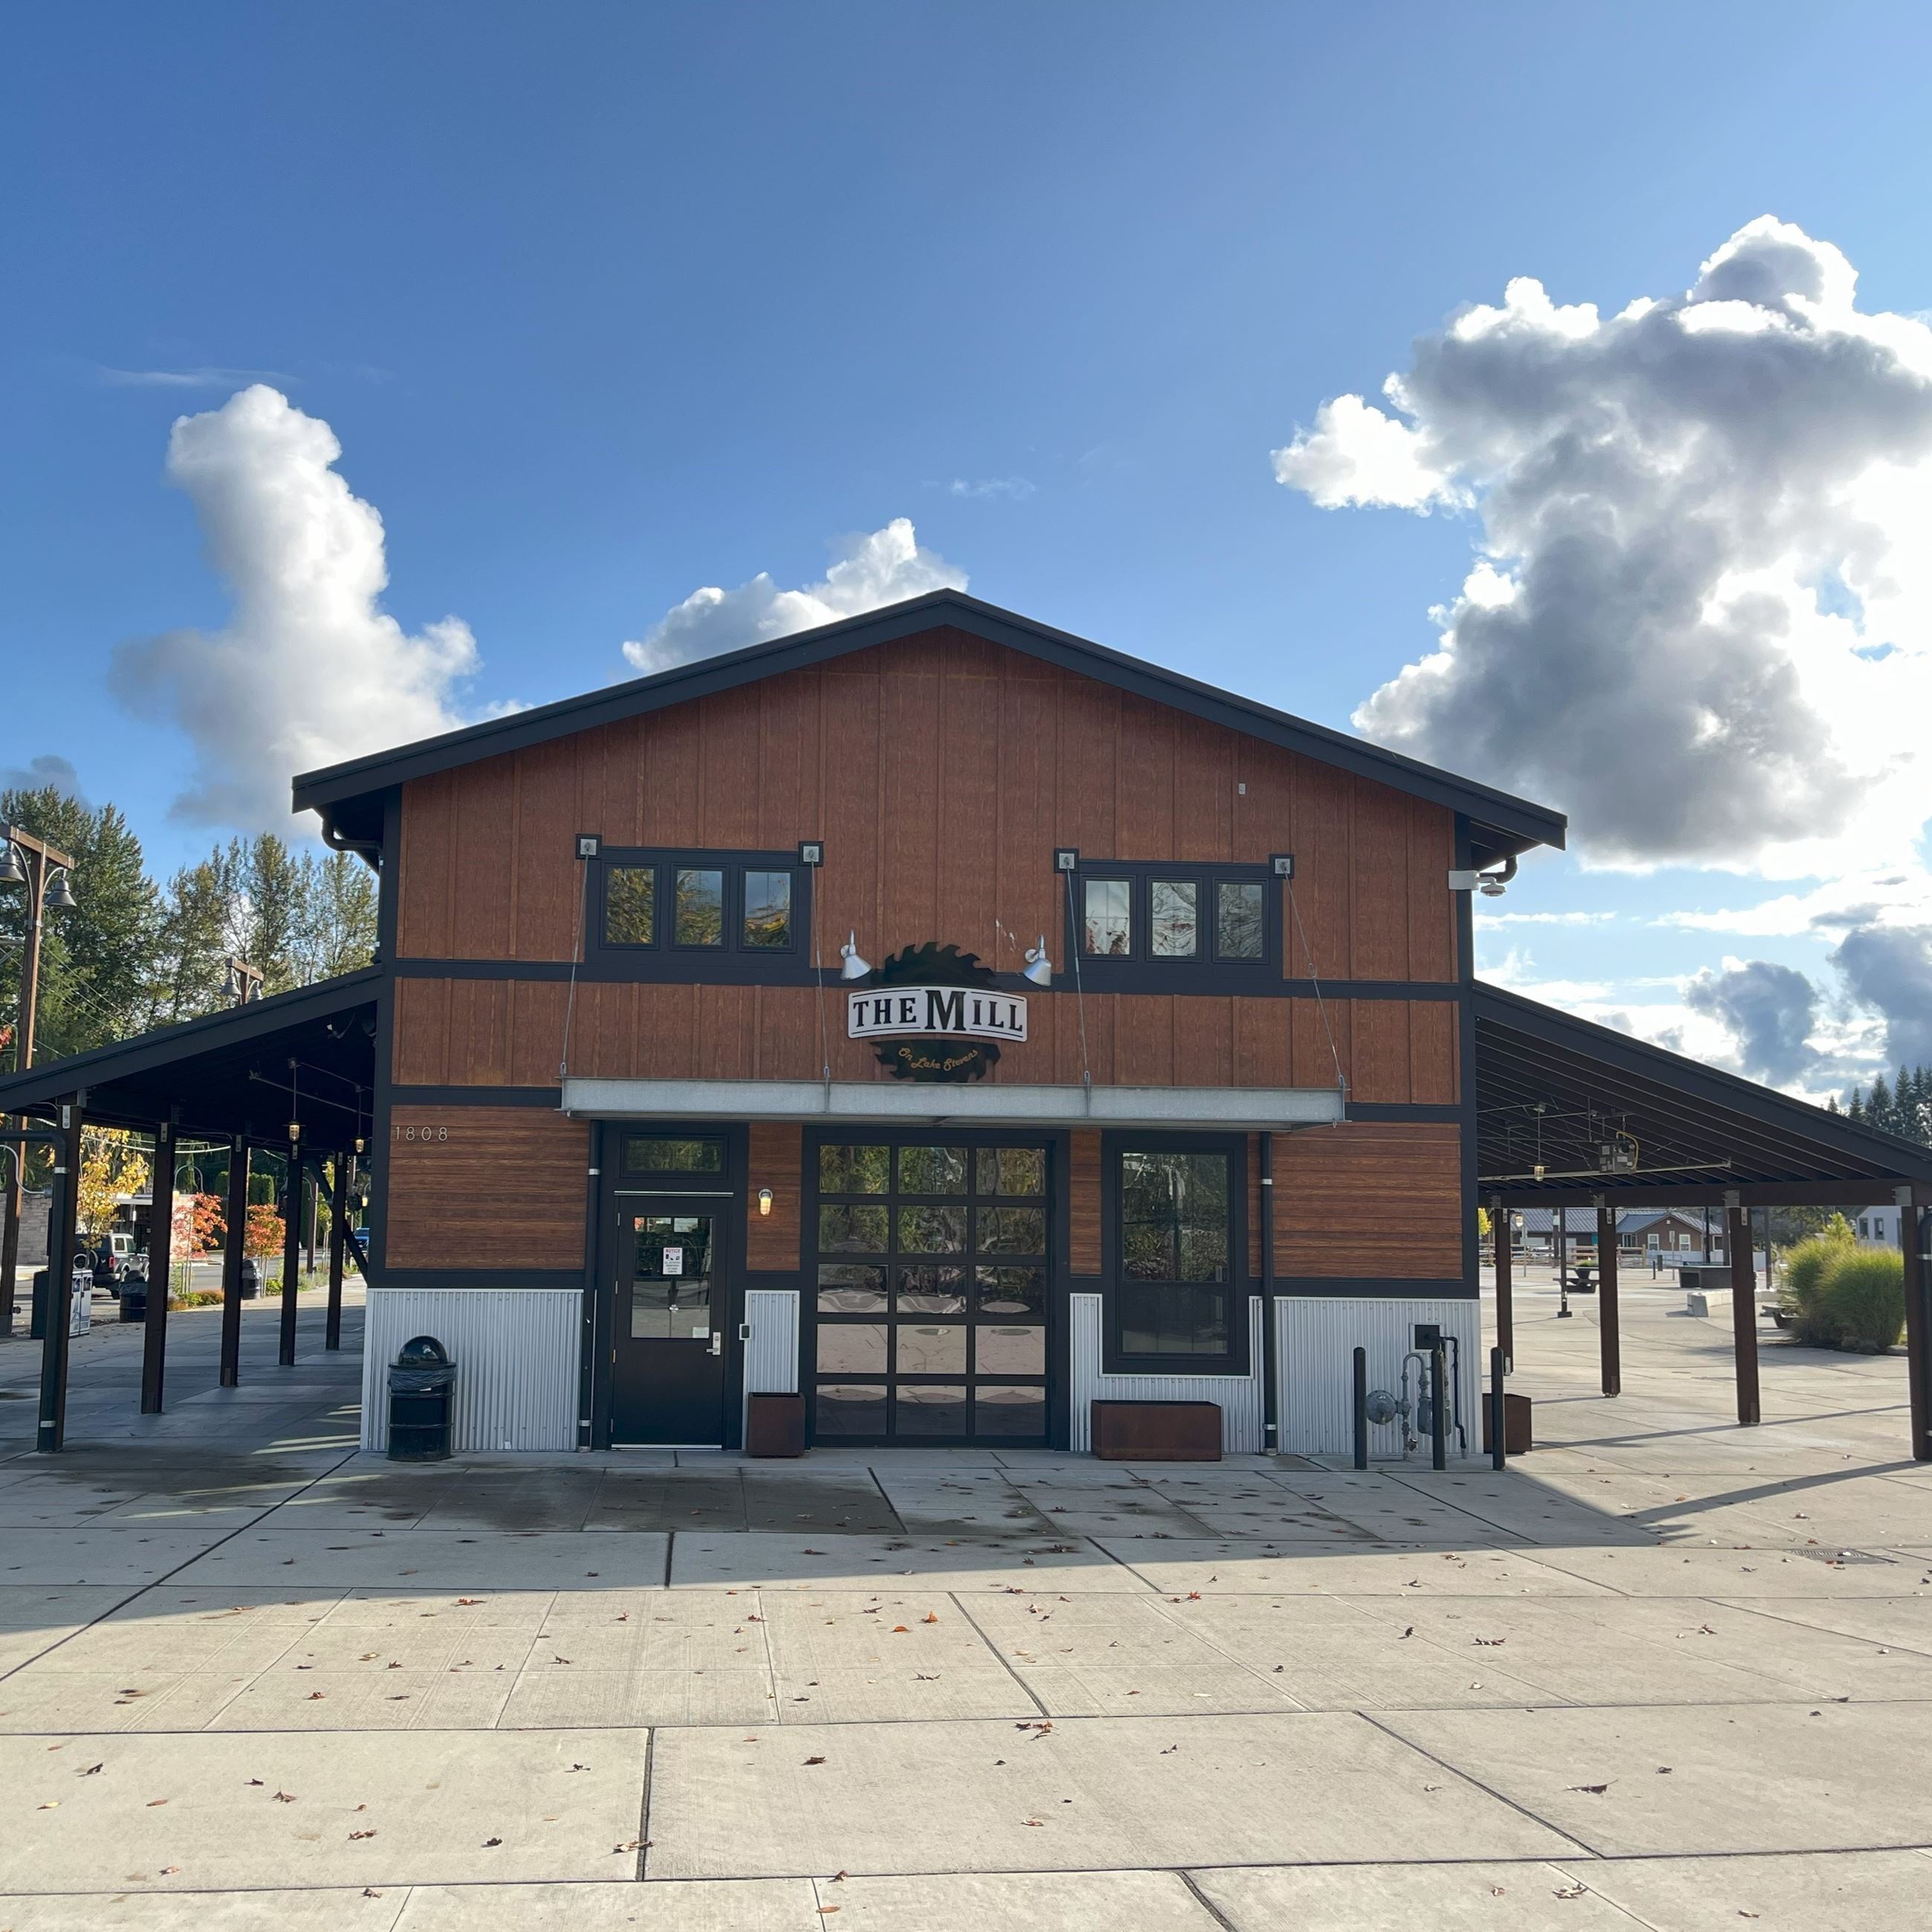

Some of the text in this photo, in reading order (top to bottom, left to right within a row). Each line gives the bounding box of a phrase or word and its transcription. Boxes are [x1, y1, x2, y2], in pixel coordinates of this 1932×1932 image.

[853, 990, 1023, 1032] THE MILL
[898, 1047, 979, 1072] On Lake Stevens
[395, 1126, 448, 1141] 1808
